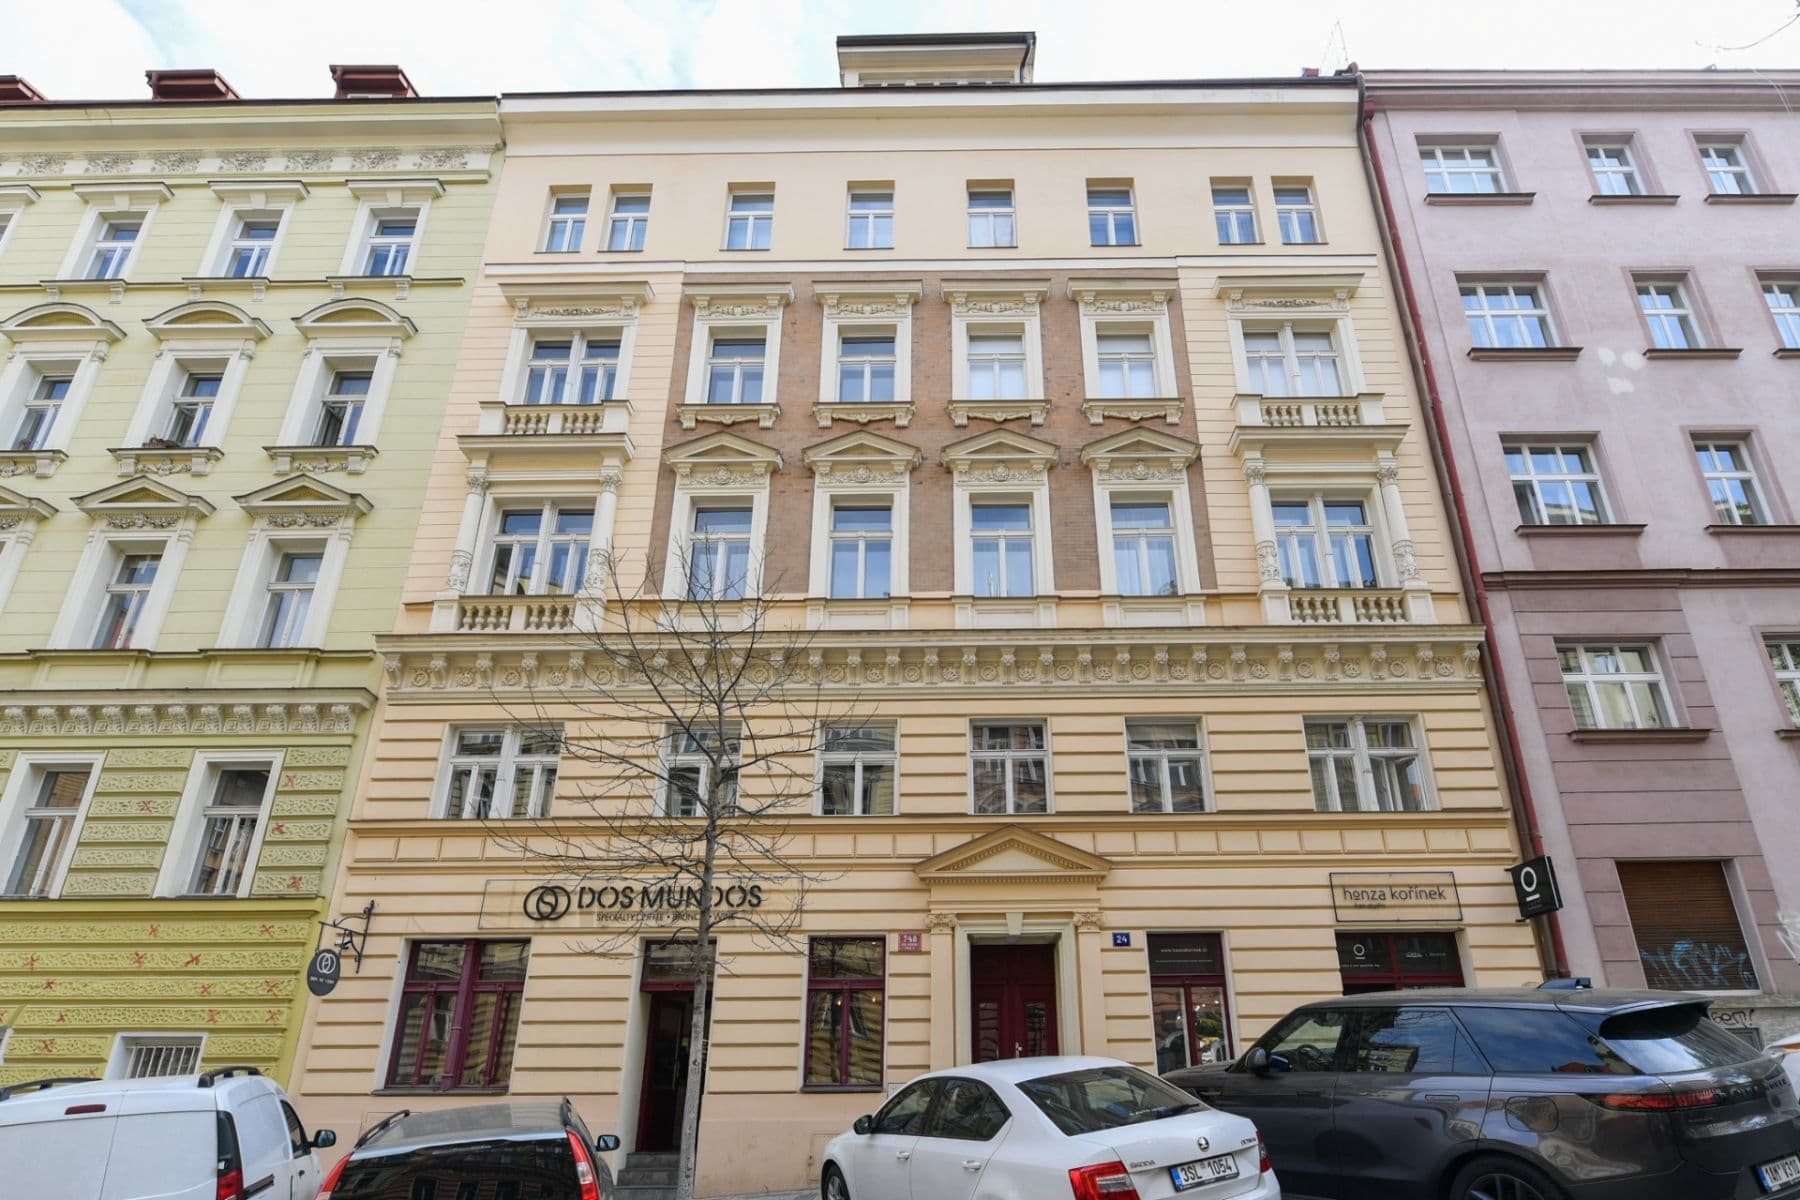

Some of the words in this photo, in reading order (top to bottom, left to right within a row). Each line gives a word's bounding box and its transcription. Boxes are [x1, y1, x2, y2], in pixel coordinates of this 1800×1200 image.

[577, 885, 634, 909] DOS
[1343, 884, 1387, 901] honza
[1389, 884, 1448, 901] kořínek
[1116, 935, 1128, 944] 24
[1181, 1163, 1203, 1183] 3SL
[1207, 1158, 1233, 1177] 1054
